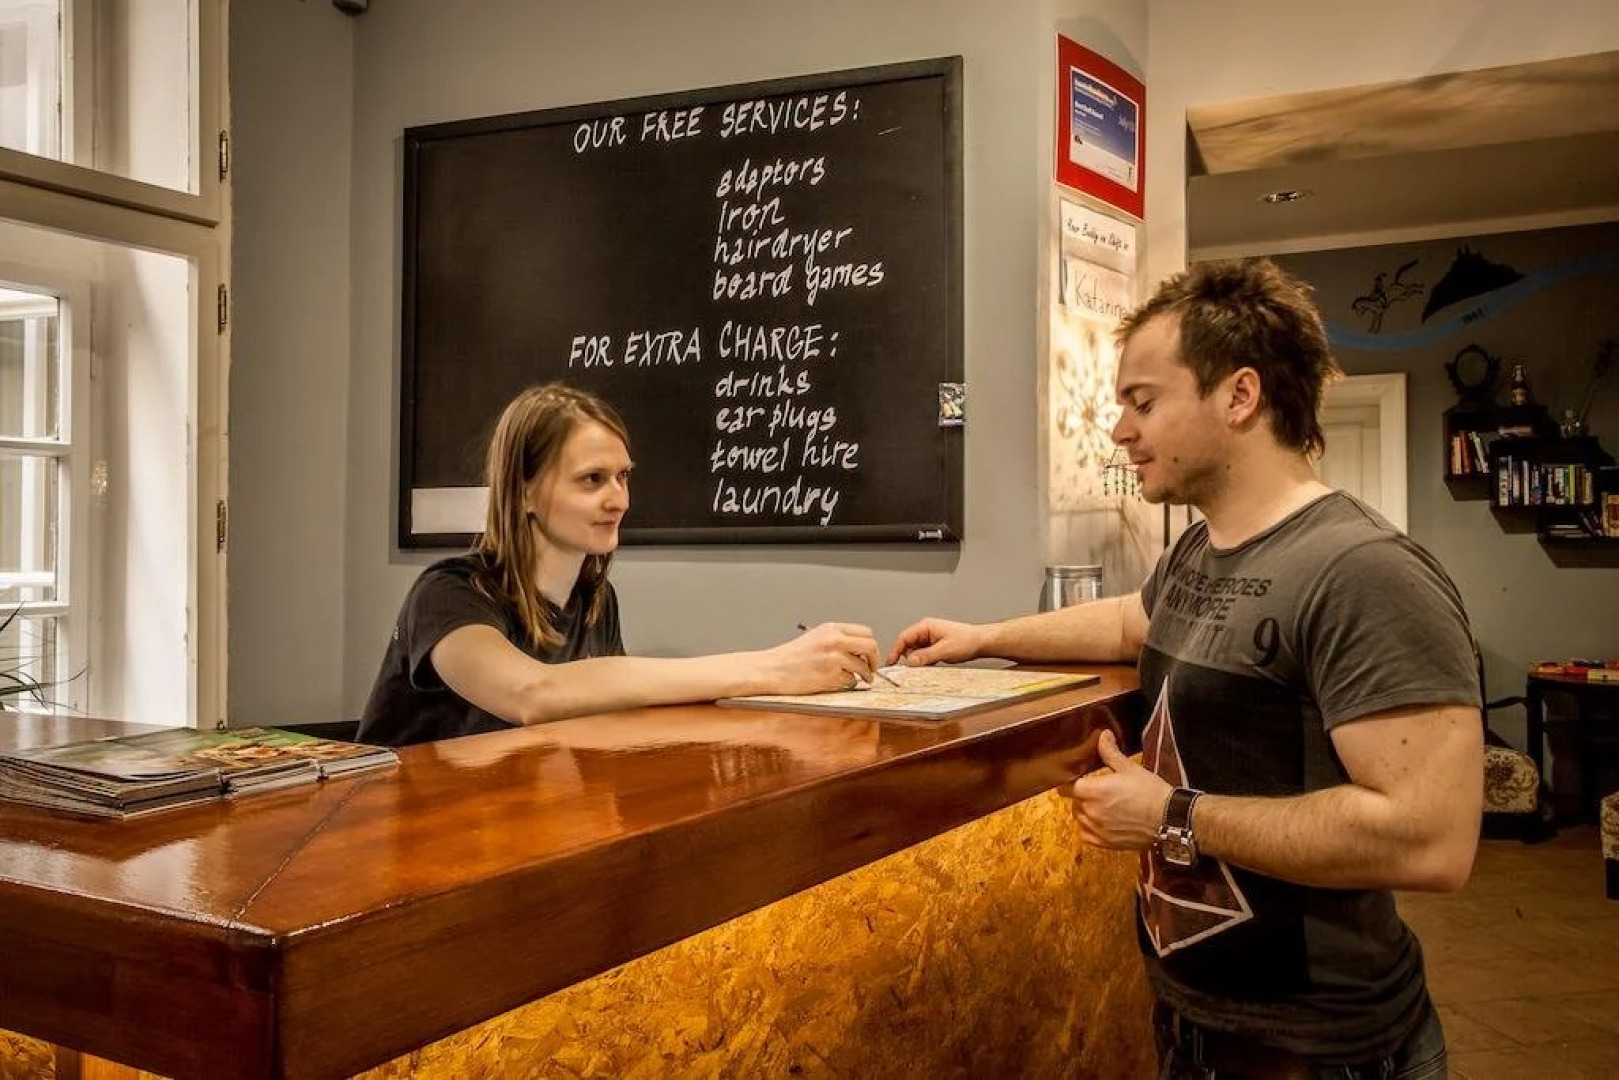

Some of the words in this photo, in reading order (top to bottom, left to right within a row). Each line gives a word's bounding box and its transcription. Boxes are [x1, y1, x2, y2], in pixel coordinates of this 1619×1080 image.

[573, 116, 627, 154] OUR
[641, 106, 706, 142] FREE
[719, 91, 861, 139] SERVICES:
[715, 156, 825, 201] adaptors
[713, 227, 853, 266] hairdryer
[712, 263, 793, 301] board
[804, 262, 885, 306] games
[568, 335, 614, 368] FOR
[623, 326, 701, 367] EXTRA
[718, 320, 840, 362] CHARGE:
[715, 364, 812, 398] drinks
[715, 405, 766, 434] ear
[768, 398, 838, 440] plugs
[710, 437, 791, 474] towel
[801, 434, 860, 469] hire
[712, 475, 839, 526] laundry
[1253, 617, 1280, 667] 9
